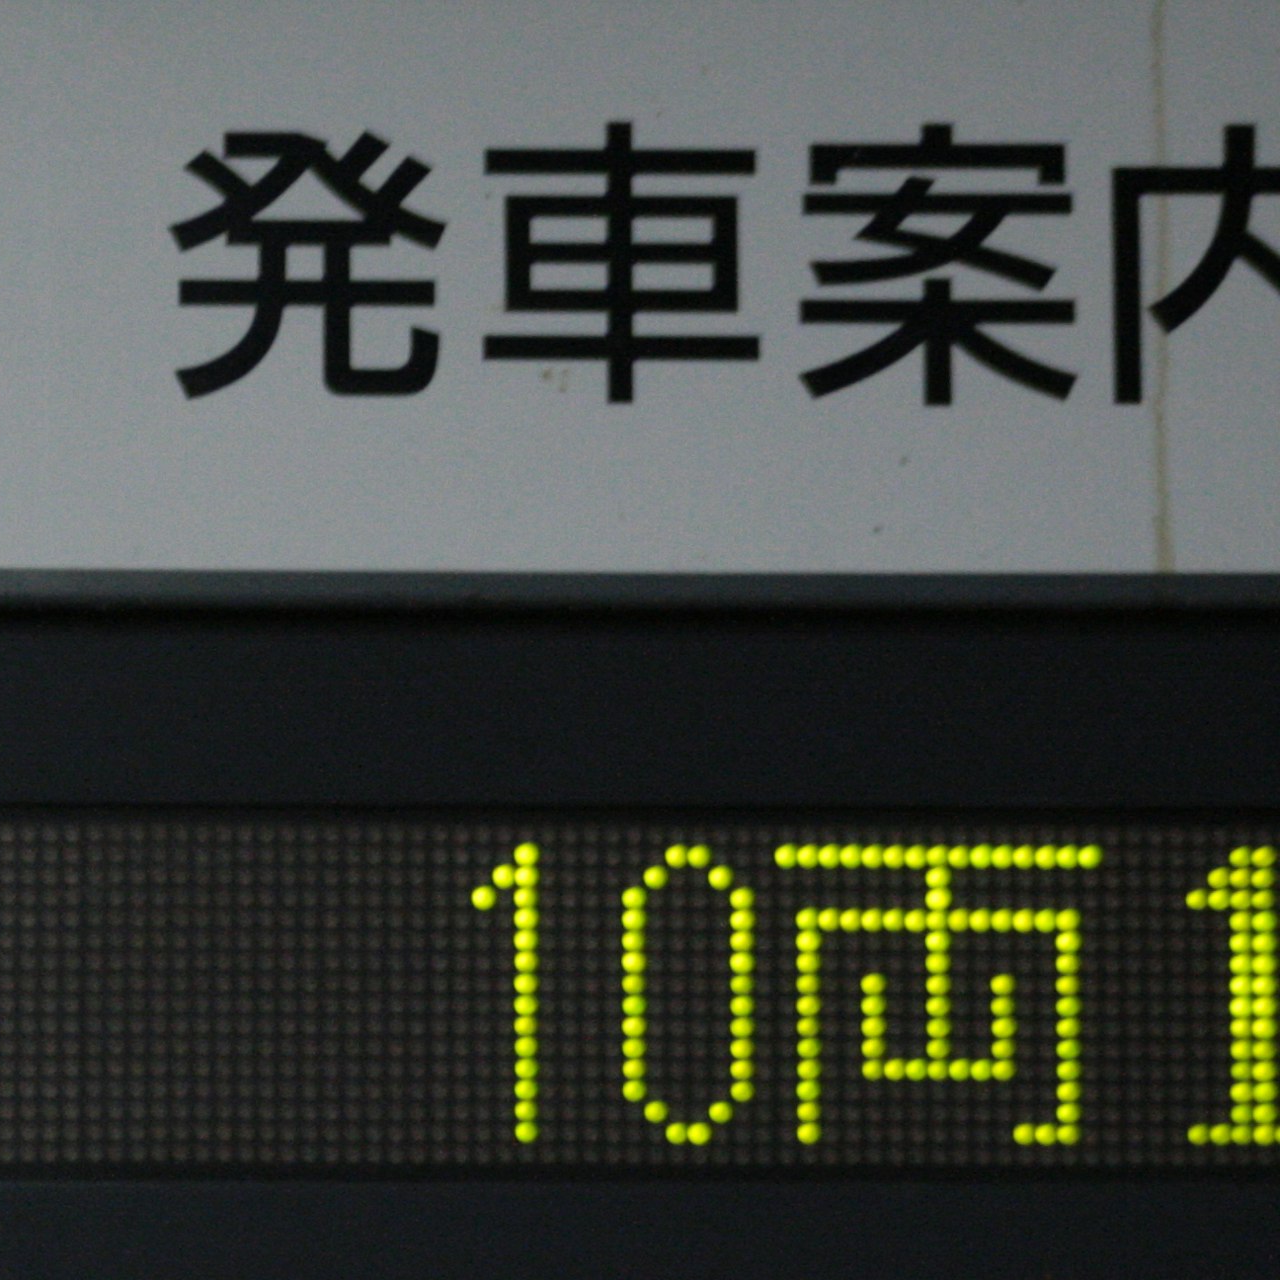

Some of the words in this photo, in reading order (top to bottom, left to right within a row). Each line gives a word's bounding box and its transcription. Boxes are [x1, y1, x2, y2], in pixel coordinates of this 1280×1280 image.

[169, 121, 1280, 406] 発車案内
[470, 841, 1102, 1146] 10両
